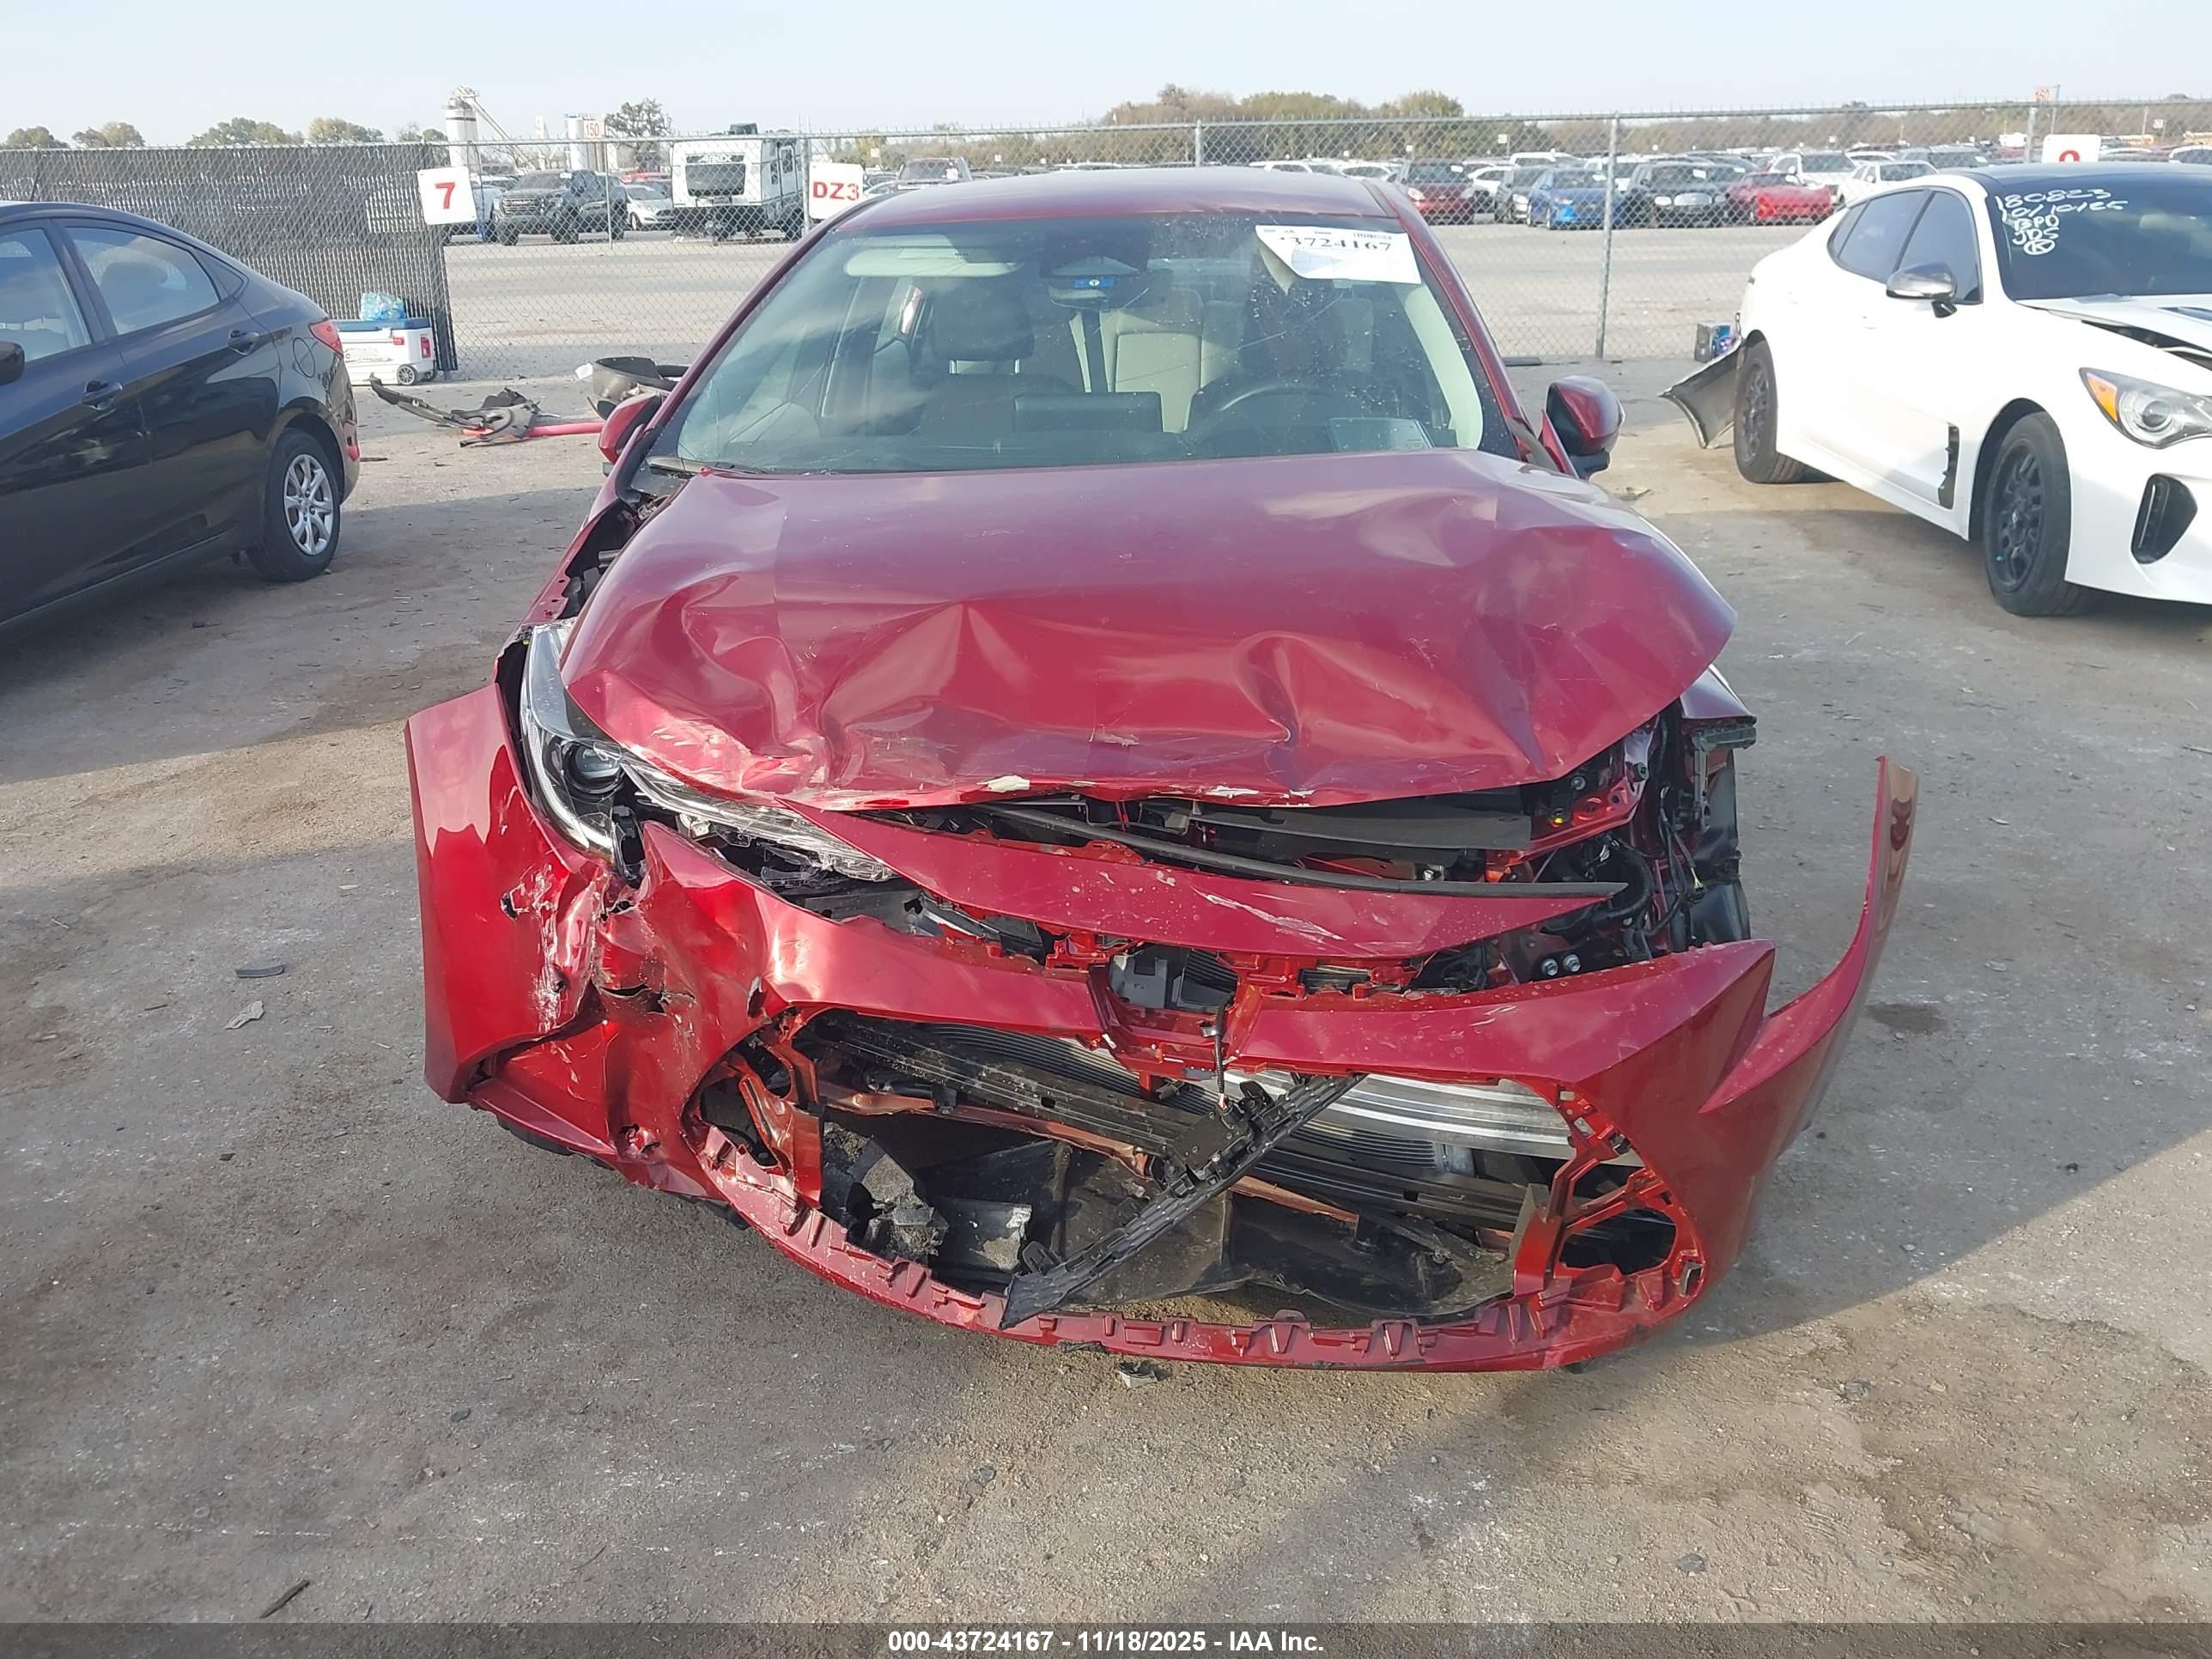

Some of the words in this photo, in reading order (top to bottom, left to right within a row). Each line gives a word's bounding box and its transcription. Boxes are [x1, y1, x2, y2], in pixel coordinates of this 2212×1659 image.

[434, 181, 455, 209] 7
[812, 181, 860, 200] DZ3
[1279, 236, 1391, 251] 3724167
[2012, 227, 2060, 245] JDS
